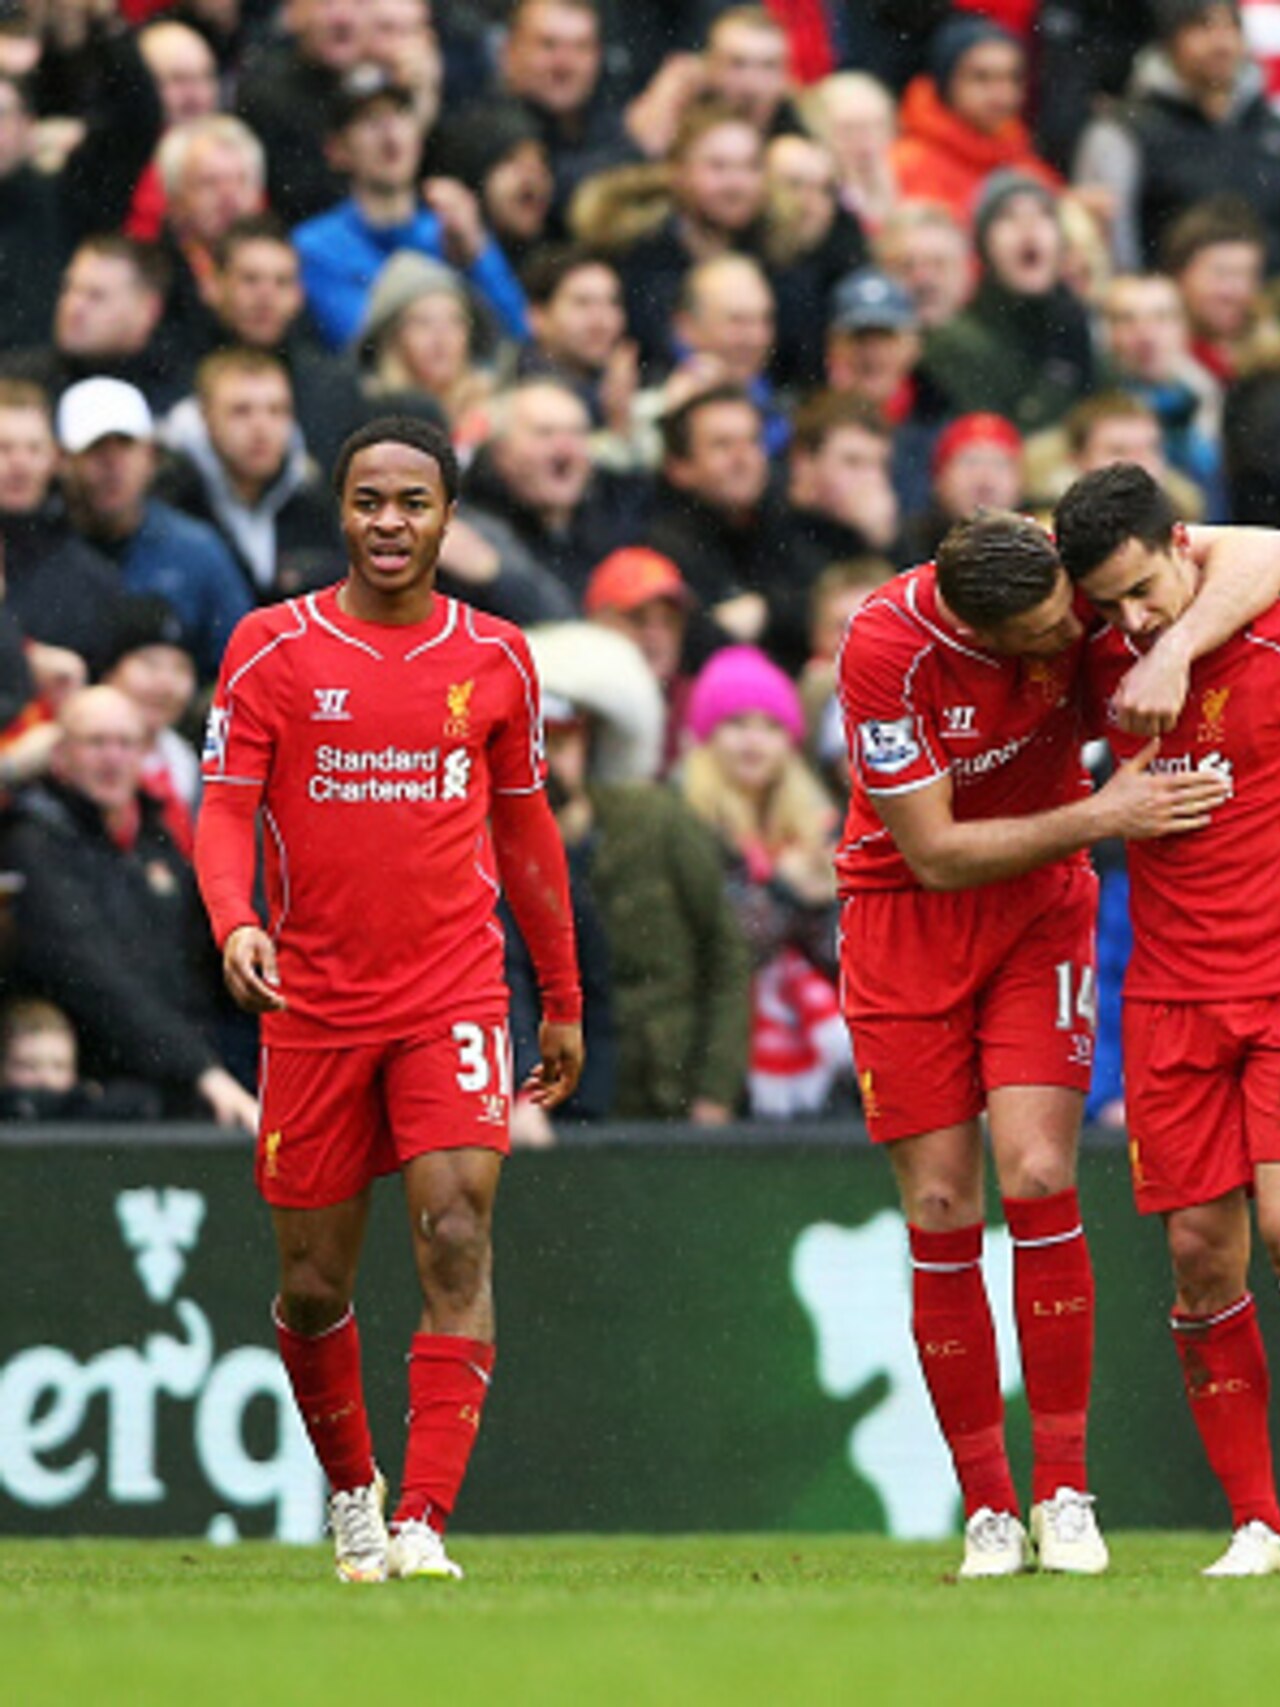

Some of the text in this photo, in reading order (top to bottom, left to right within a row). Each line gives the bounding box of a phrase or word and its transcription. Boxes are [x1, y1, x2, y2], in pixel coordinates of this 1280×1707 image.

[316, 745, 438, 772] Standard
[308, 775, 437, 802] Chartered
[1055, 962, 1095, 1030] 14
[451, 1021, 509, 1094] 31
